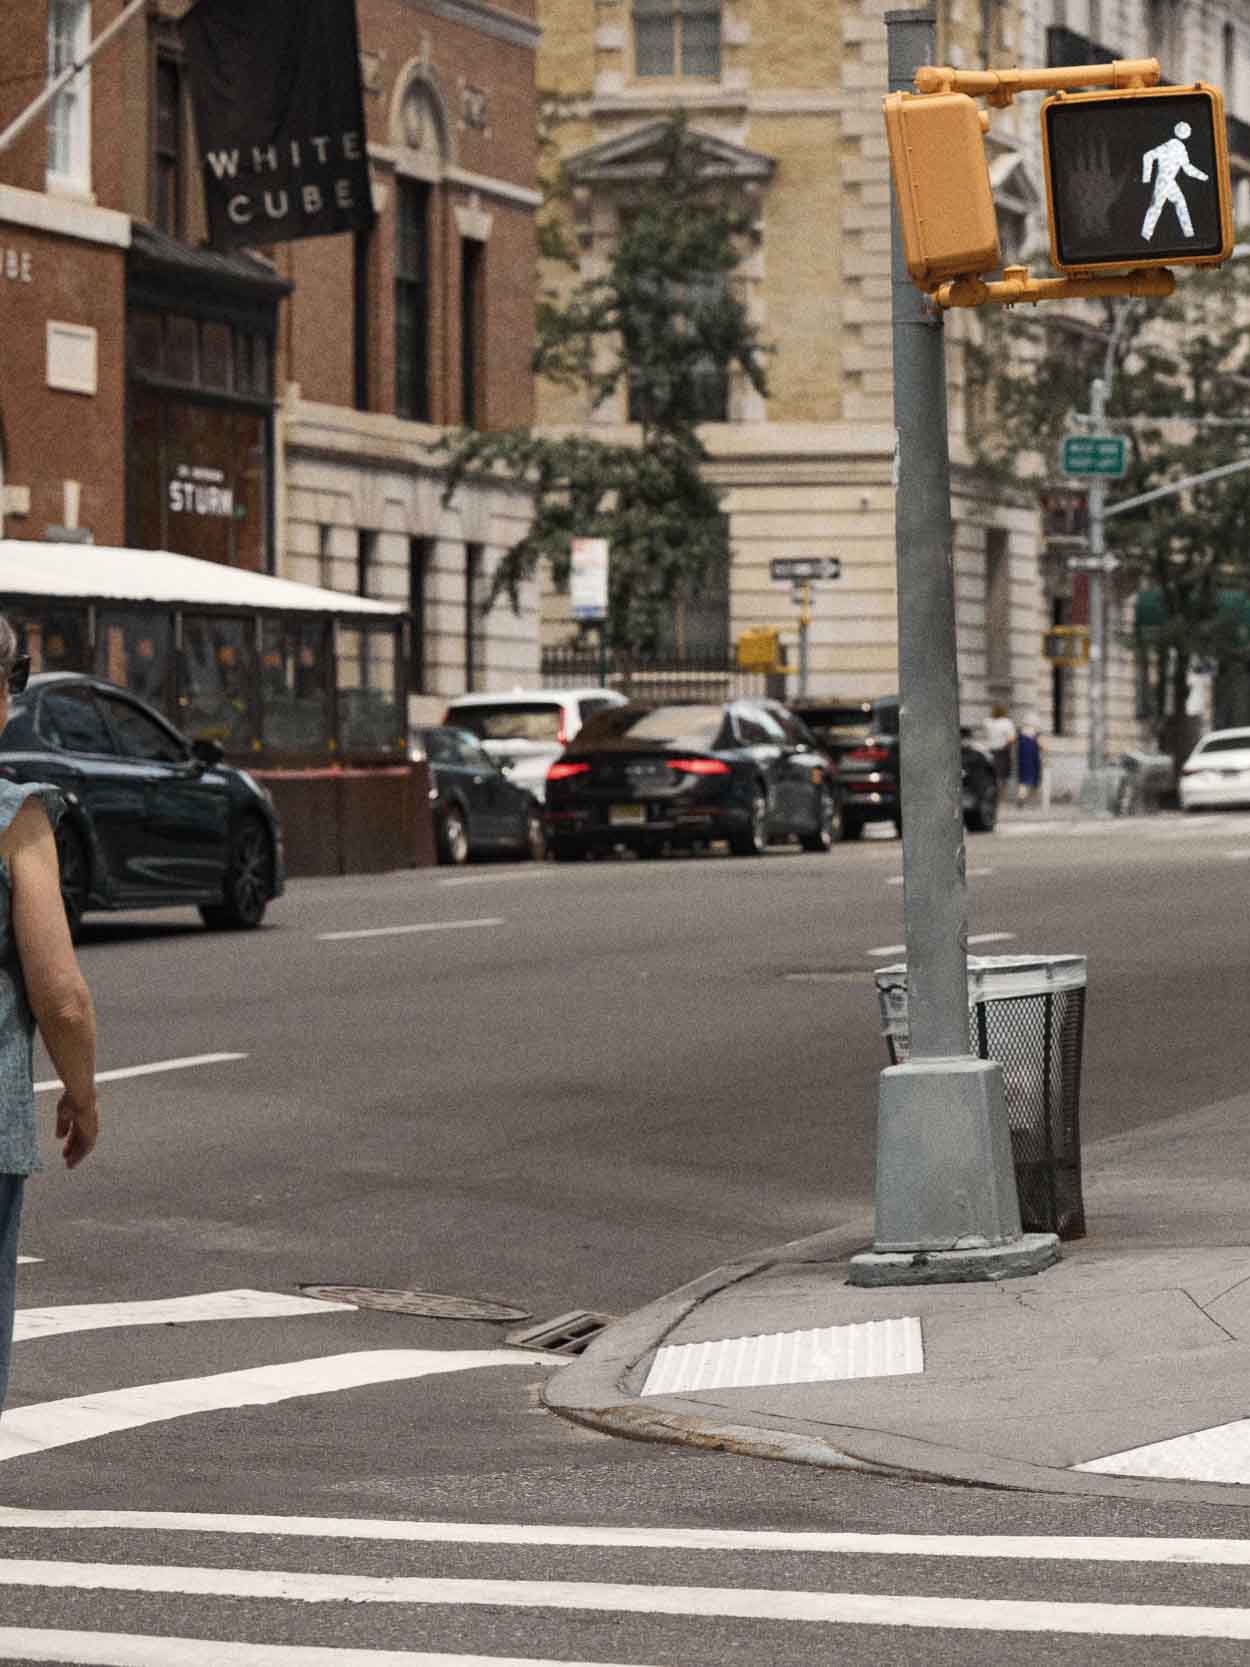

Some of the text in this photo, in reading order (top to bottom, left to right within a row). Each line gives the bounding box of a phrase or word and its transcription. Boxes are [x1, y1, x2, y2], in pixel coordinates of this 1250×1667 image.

[207, 132, 361, 179] WHITE
[228, 179, 352, 223] CUBE
[0, 248, 32, 282] BE
